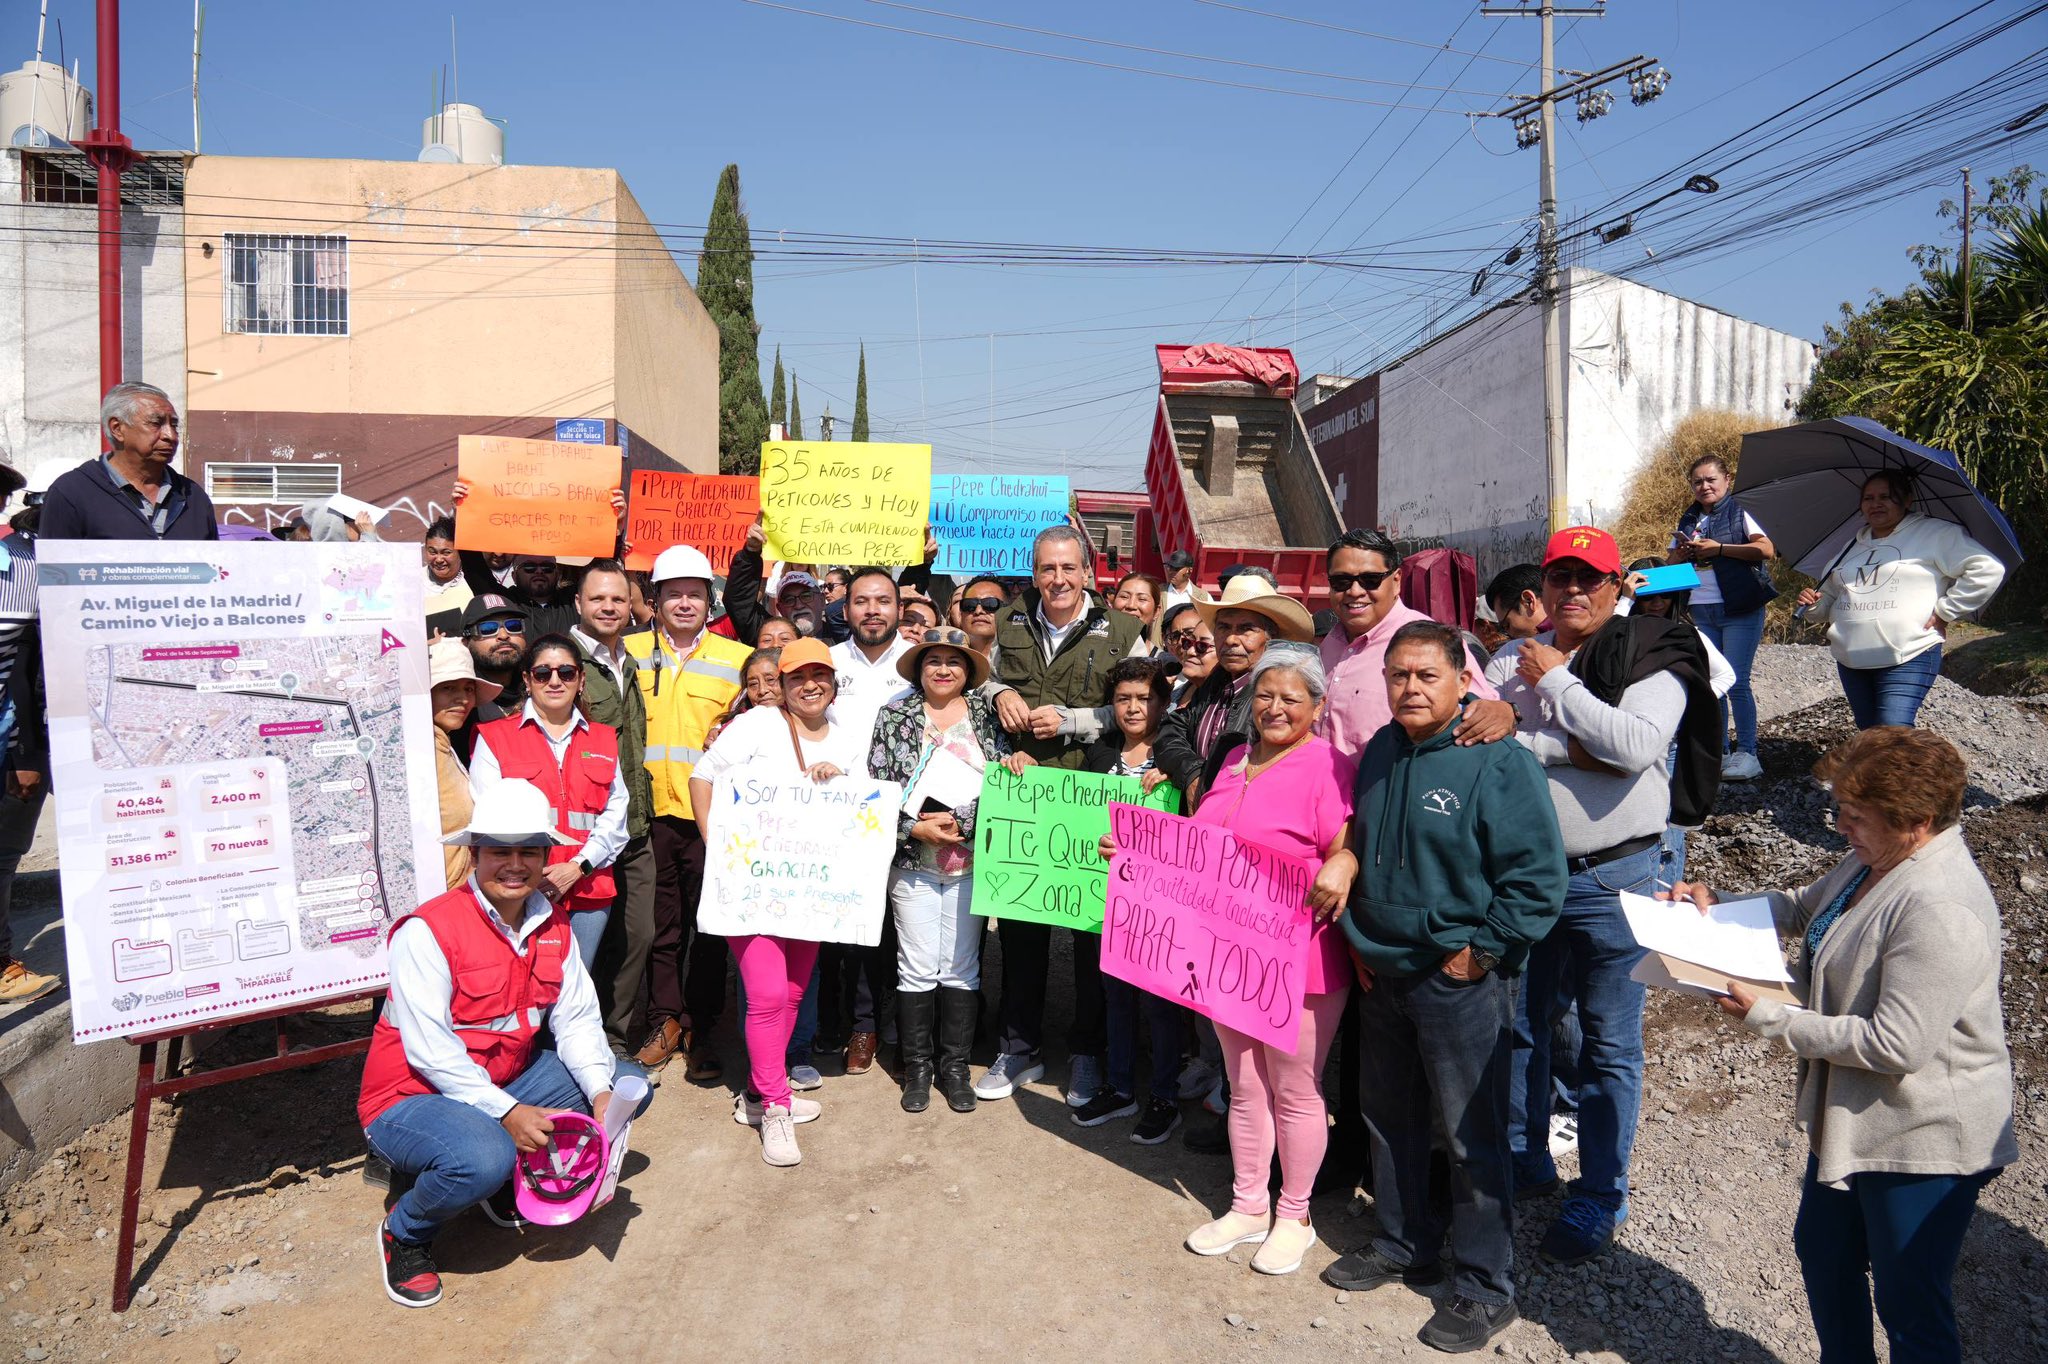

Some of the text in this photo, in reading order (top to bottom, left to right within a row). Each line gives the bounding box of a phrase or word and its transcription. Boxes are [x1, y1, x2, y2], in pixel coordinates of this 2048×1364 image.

[1347, 407, 1359, 431] DEL
[1361, 398, 1374, 424] SUR
[819, 461, 860, 479] AÑOS
[872, 466, 894, 482] DE
[494, 482, 610, 502] NICOLAS BRAVO
[952, 476, 1048, 498] Pepe Chedrahui
[767, 490, 852, 509] PETICONES
[675, 501, 732, 520] GRACIAS
[960, 503, 1036, 526] Compromiso
[1041, 510, 1065, 522] nos
[489, 513, 553, 528] GRACIAS
[560, 513, 576, 526] POR
[768, 516, 791, 533] SE
[840, 522, 918, 537] CUMPLIENDO
[532, 530, 572, 544] APOYO
[634, 519, 734, 542] POR HACER EL
[931, 525, 1036, 539] mueve hacia un
[782, 540, 853, 557] GRACIAS
[1572, 538, 1590, 548] PT
[1863, 550, 1881, 566] L
[103, 566, 190, 574] Rehabilitación vial
[132, 573, 200, 582] complementarias
[1852, 564, 1882, 587] M
[81, 599, 110, 611] Av.
[115, 596, 179, 612] Miguel
[184, 596, 207, 608] de
[211, 596, 226, 608] la
[230, 594, 291, 608] Madrid
[1853, 600, 1898, 611] MIGUEL
[81, 613, 306, 630] Camino Viejo a Balcones
[383, 636, 395, 648] N
[212, 683, 234, 691] Miguel
[211, 793, 246, 805] 2,400
[790, 787, 812, 804] TU
[1007, 772, 1056, 814] Pepe
[117, 796, 163, 808] 40,484
[117, 808, 165, 818] habitantes
[211, 838, 269, 852] 70 nuevas
[111, 853, 151, 866] 31,386
[1115, 808, 1311, 915] GRACIAS POR UNA
[165, 871, 244, 887] Colonias Beneficiadas
[751, 860, 831, 882] GRACIAS
[159, 893, 191, 902] Mexicana
[1007, 871, 1082, 917] Zona
[1133, 863, 1220, 915] Movilidad
[1109, 895, 1293, 1028] PARA TODOS
[240, 975, 291, 990] IMPARABLE
